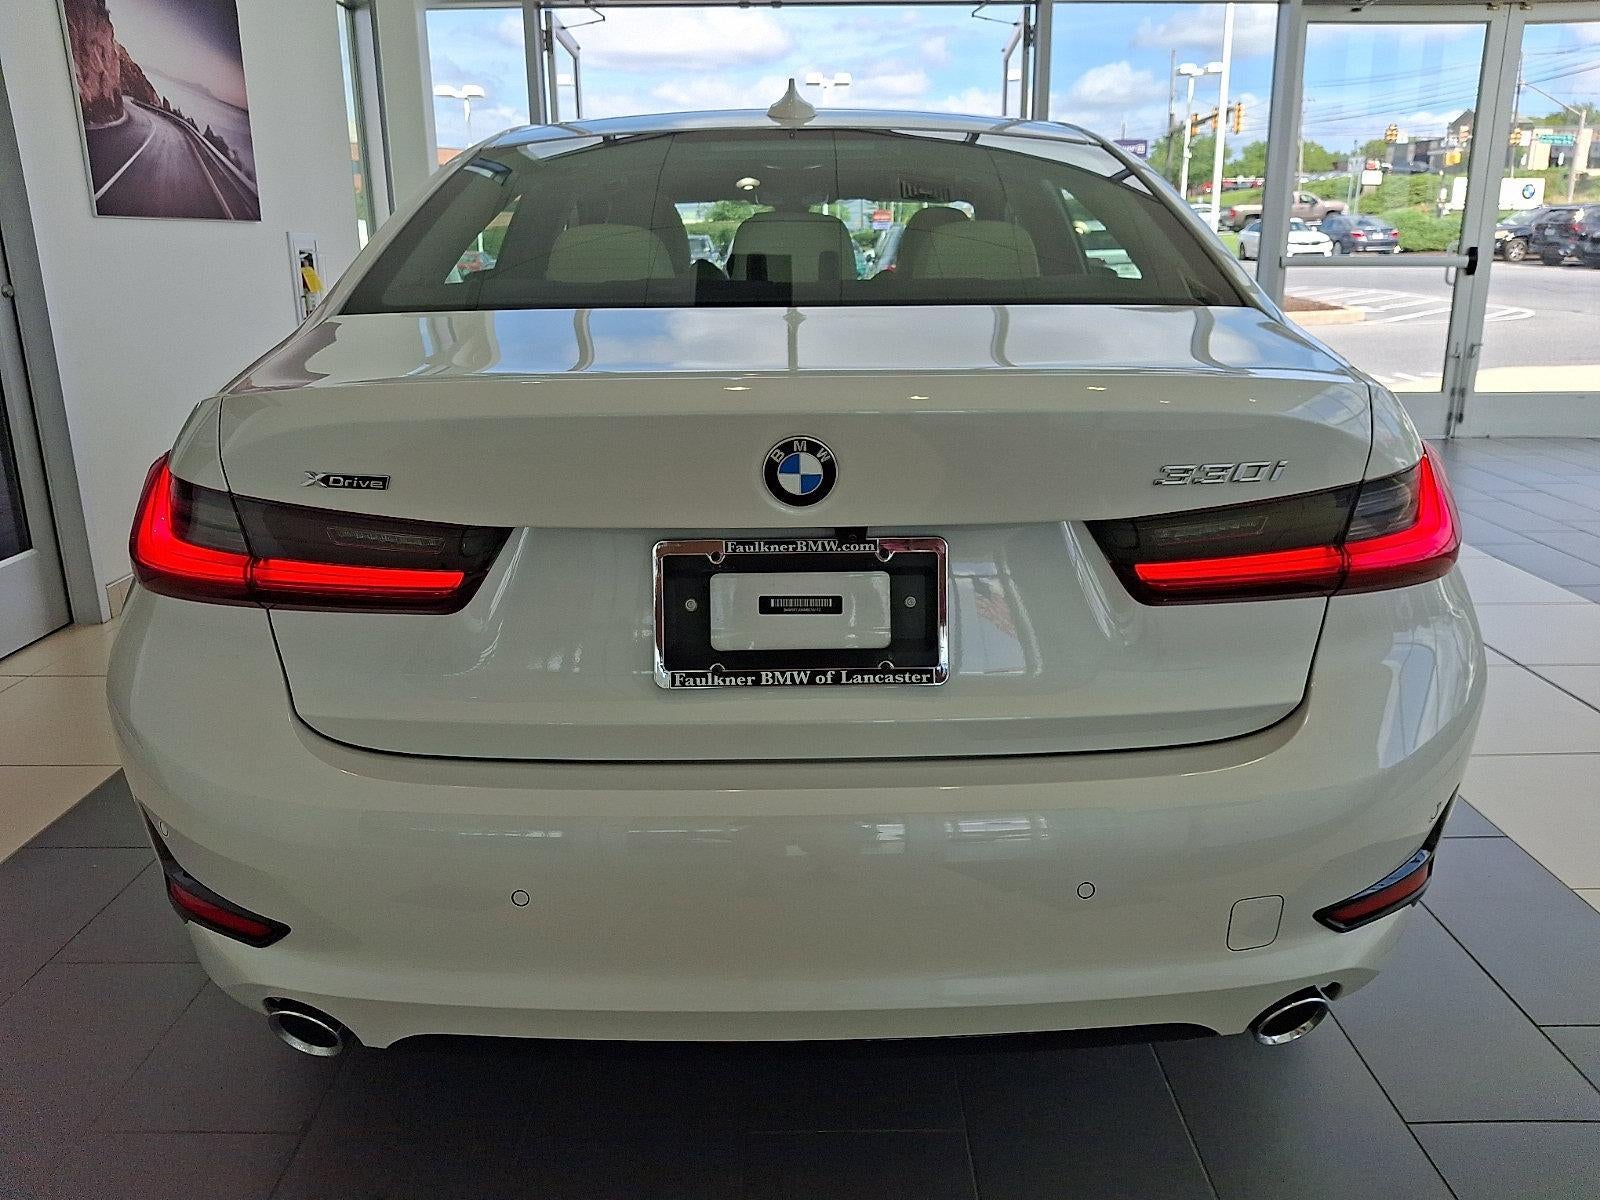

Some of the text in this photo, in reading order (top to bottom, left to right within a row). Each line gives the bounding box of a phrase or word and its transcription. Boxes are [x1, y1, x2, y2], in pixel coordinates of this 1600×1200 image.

[770, 440, 831, 463] BMW
[1153, 460, 1288, 486] 330i
[726, 540, 876, 554] FaulknerBMW.com
[674, 671, 931, 687] Faulkner BMW of Lancaster
